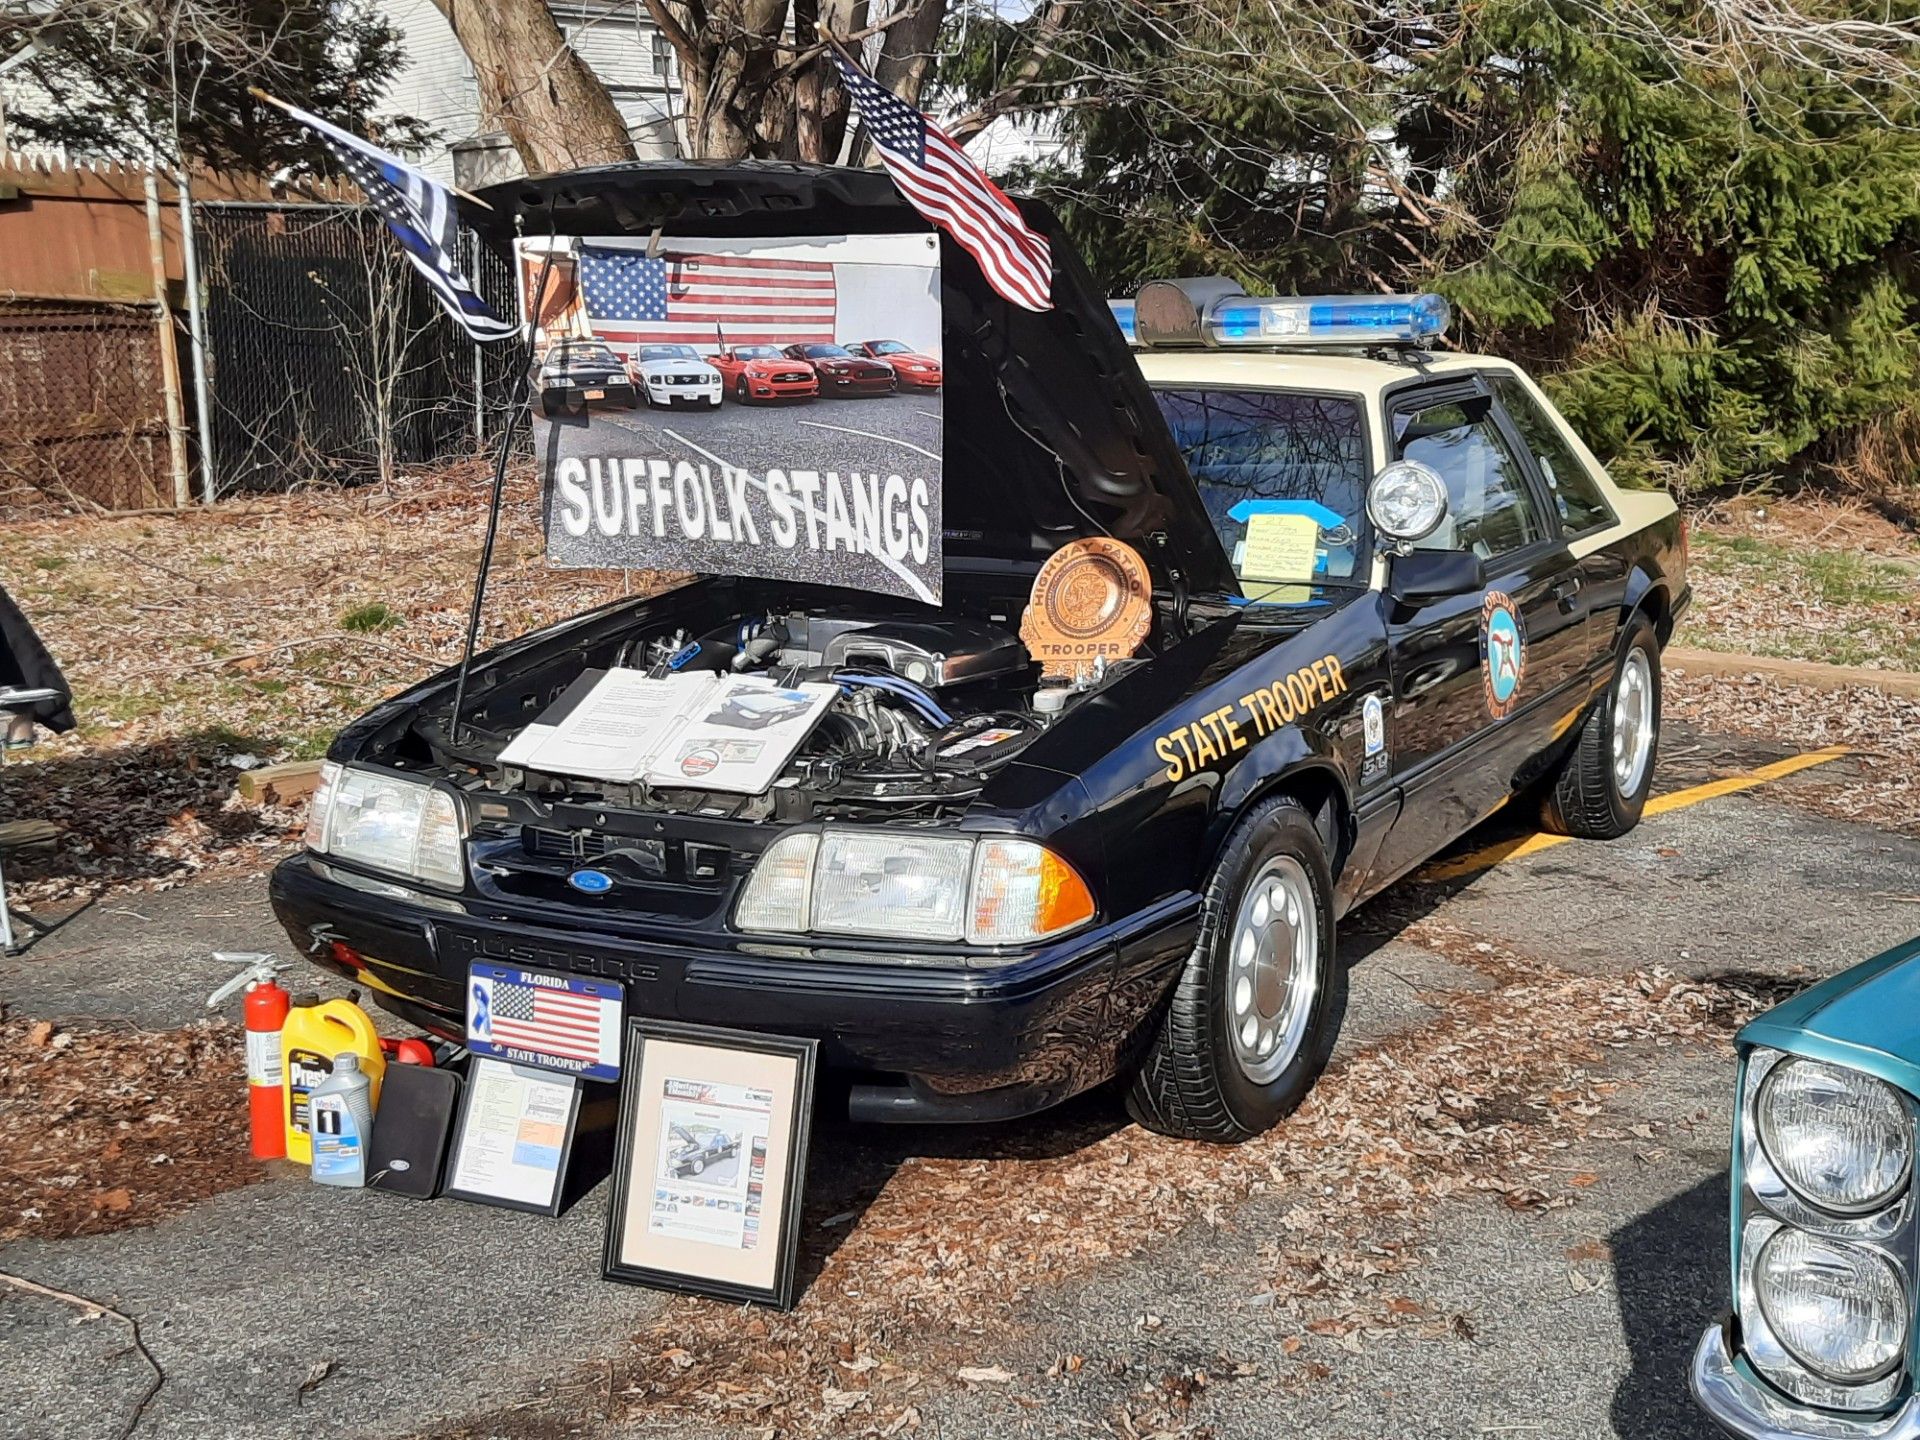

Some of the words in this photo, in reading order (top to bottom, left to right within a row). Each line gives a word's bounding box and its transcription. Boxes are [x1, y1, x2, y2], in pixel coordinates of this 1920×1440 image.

[558, 457, 760, 545] SUFFOLK
[767, 470, 929, 564] STANGS
[1035, 542, 1093, 606] HIGHWAY
[1102, 543, 1143, 603] PATROL
[1041, 643, 1120, 655] TROOPER
[1155, 705, 1247, 783] STATE
[1239, 654, 1347, 737] TROOPER
[520, 972, 570, 990] FLORIDA
[507, 1048, 536, 1063] STATE
[537, 1054, 582, 1072] TROOPER
[316, 1099, 340, 1110] Mobil
[322, 1111, 333, 1133] 1
